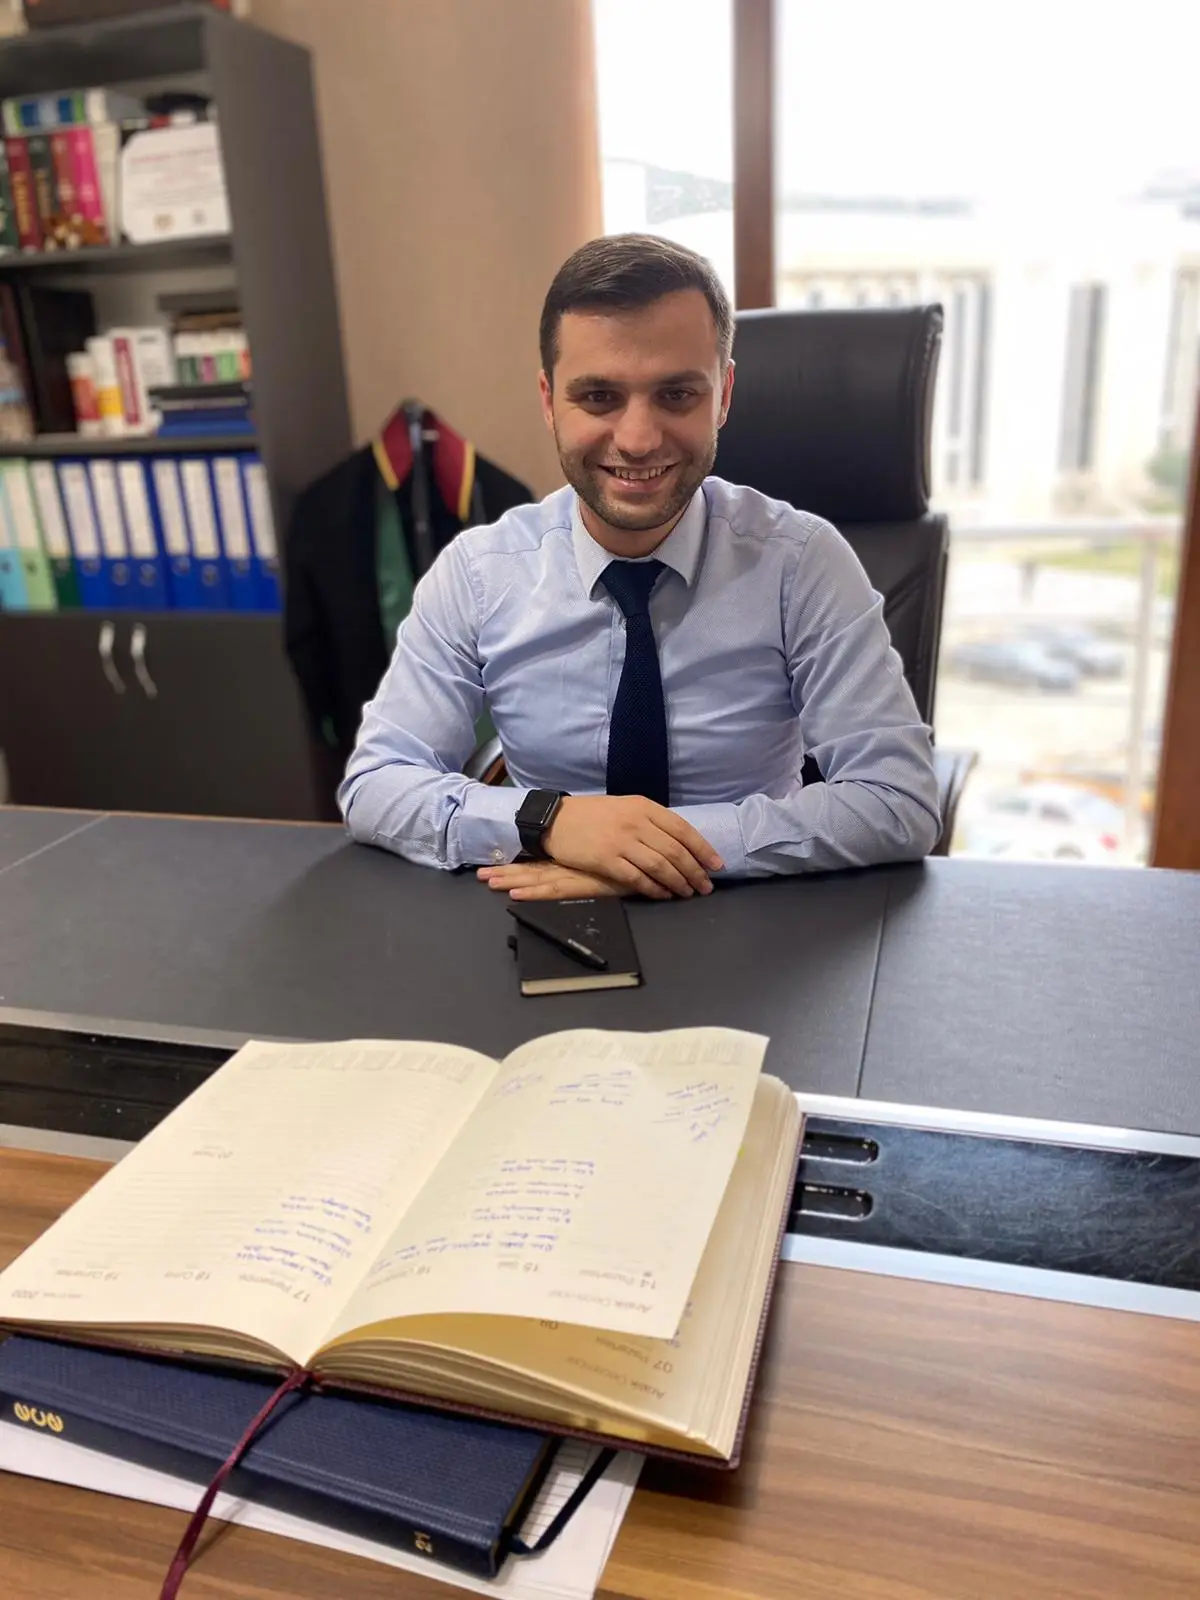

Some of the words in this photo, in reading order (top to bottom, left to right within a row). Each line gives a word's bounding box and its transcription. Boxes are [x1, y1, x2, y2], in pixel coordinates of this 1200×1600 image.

[639, 1279, 657, 1290] 14
[292, 1289, 311, 1303] 17
[596, 1336, 649, 1365] Pazartesi
[652, 1360, 674, 1374] 07
[631, 1380, 666, 1400] Aralık
